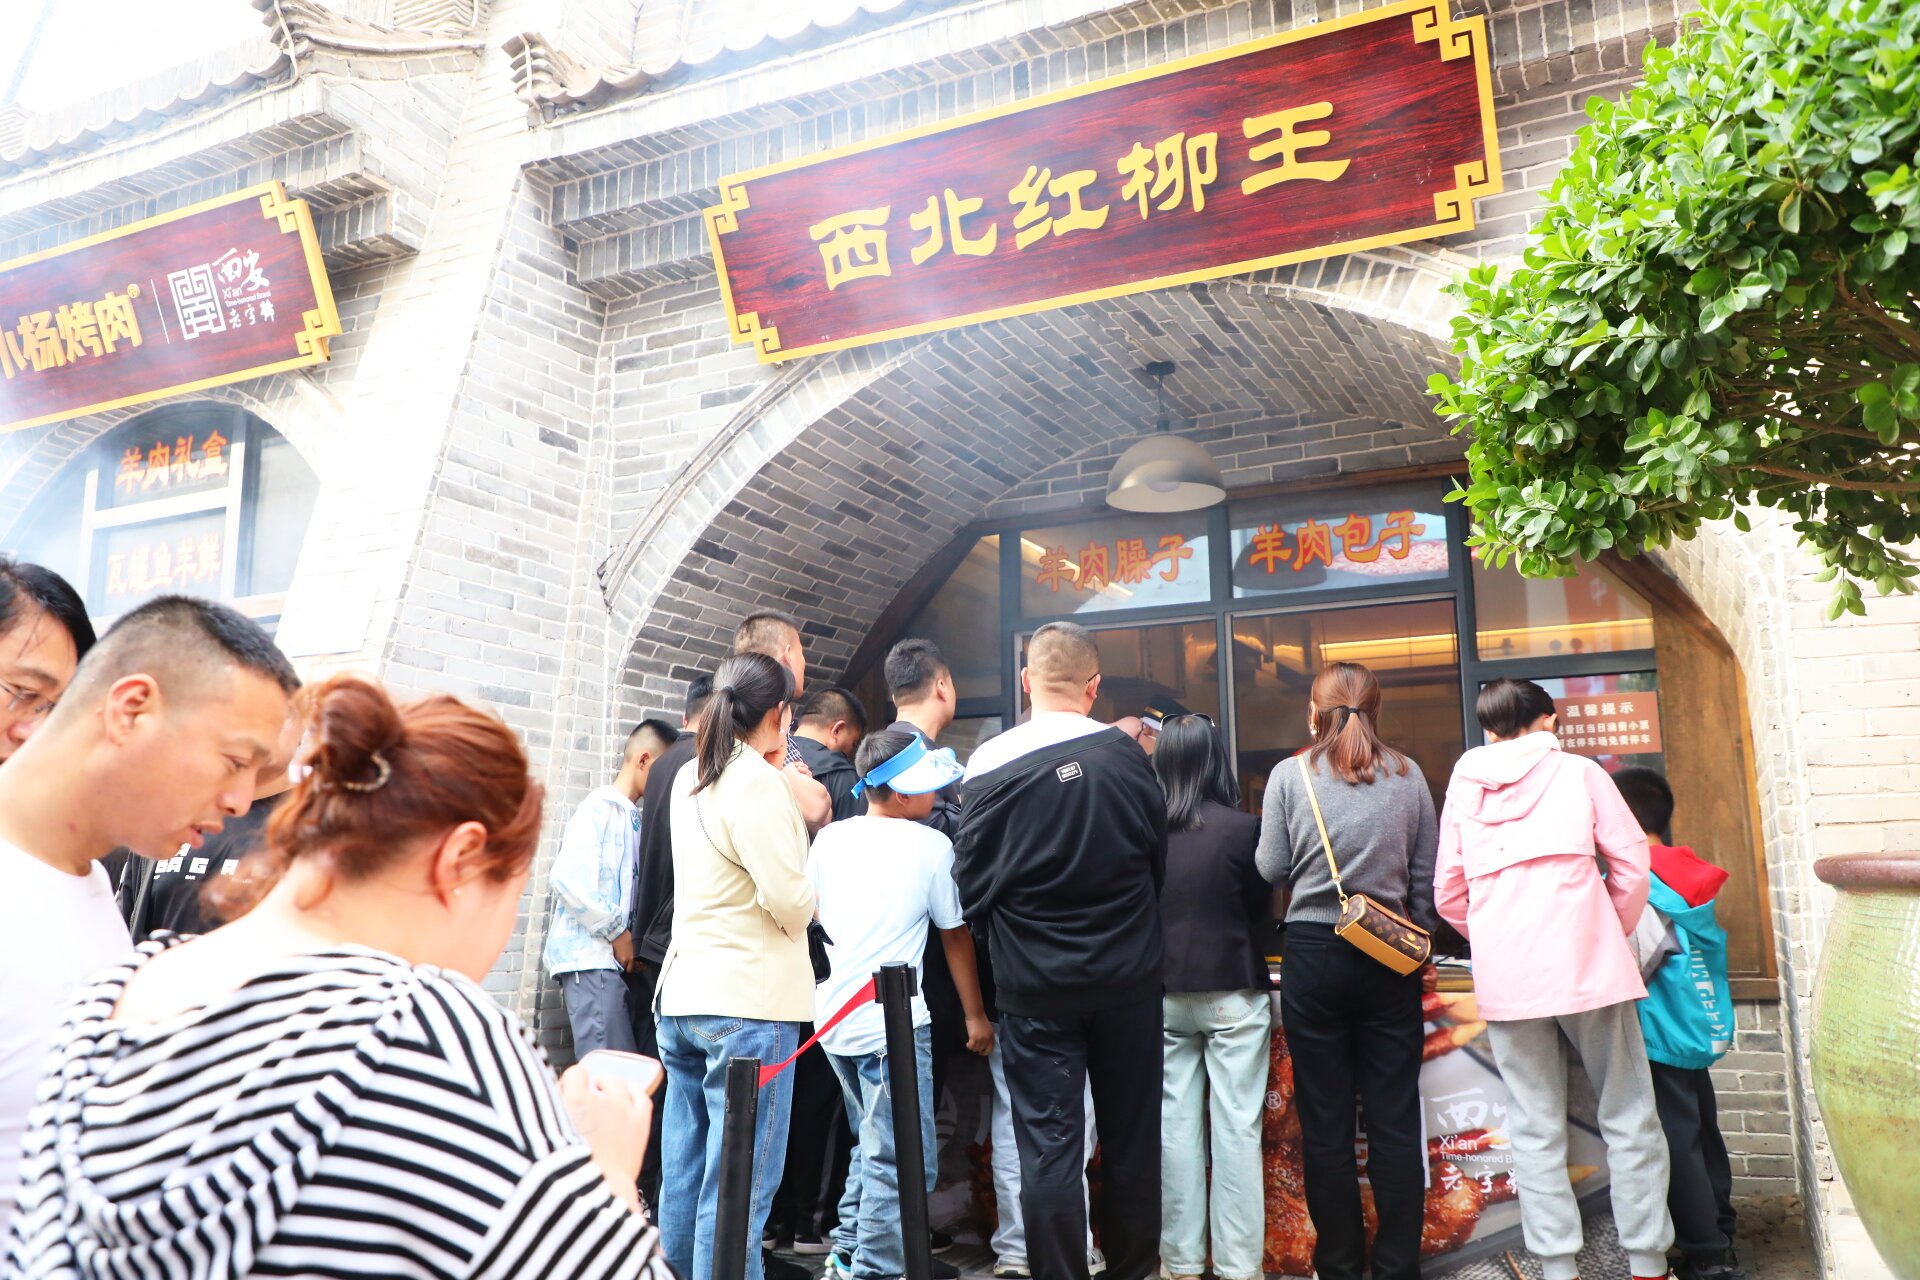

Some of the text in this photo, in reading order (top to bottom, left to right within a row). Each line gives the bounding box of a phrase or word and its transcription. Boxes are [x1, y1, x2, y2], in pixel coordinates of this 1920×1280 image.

[809, 101, 1351, 291] 西北红柳王
[115, 429, 228, 494] 羊肉礼盒
[1035, 532, 1194, 592] 羊肉臊子
[1249, 509, 1427, 575] 羊肉包子
[1566, 702, 1634, 718] 温馨提示
[1439, 1134, 1478, 1151] Xi'an
[1440, 1151, 1503, 1164] Time-honored
